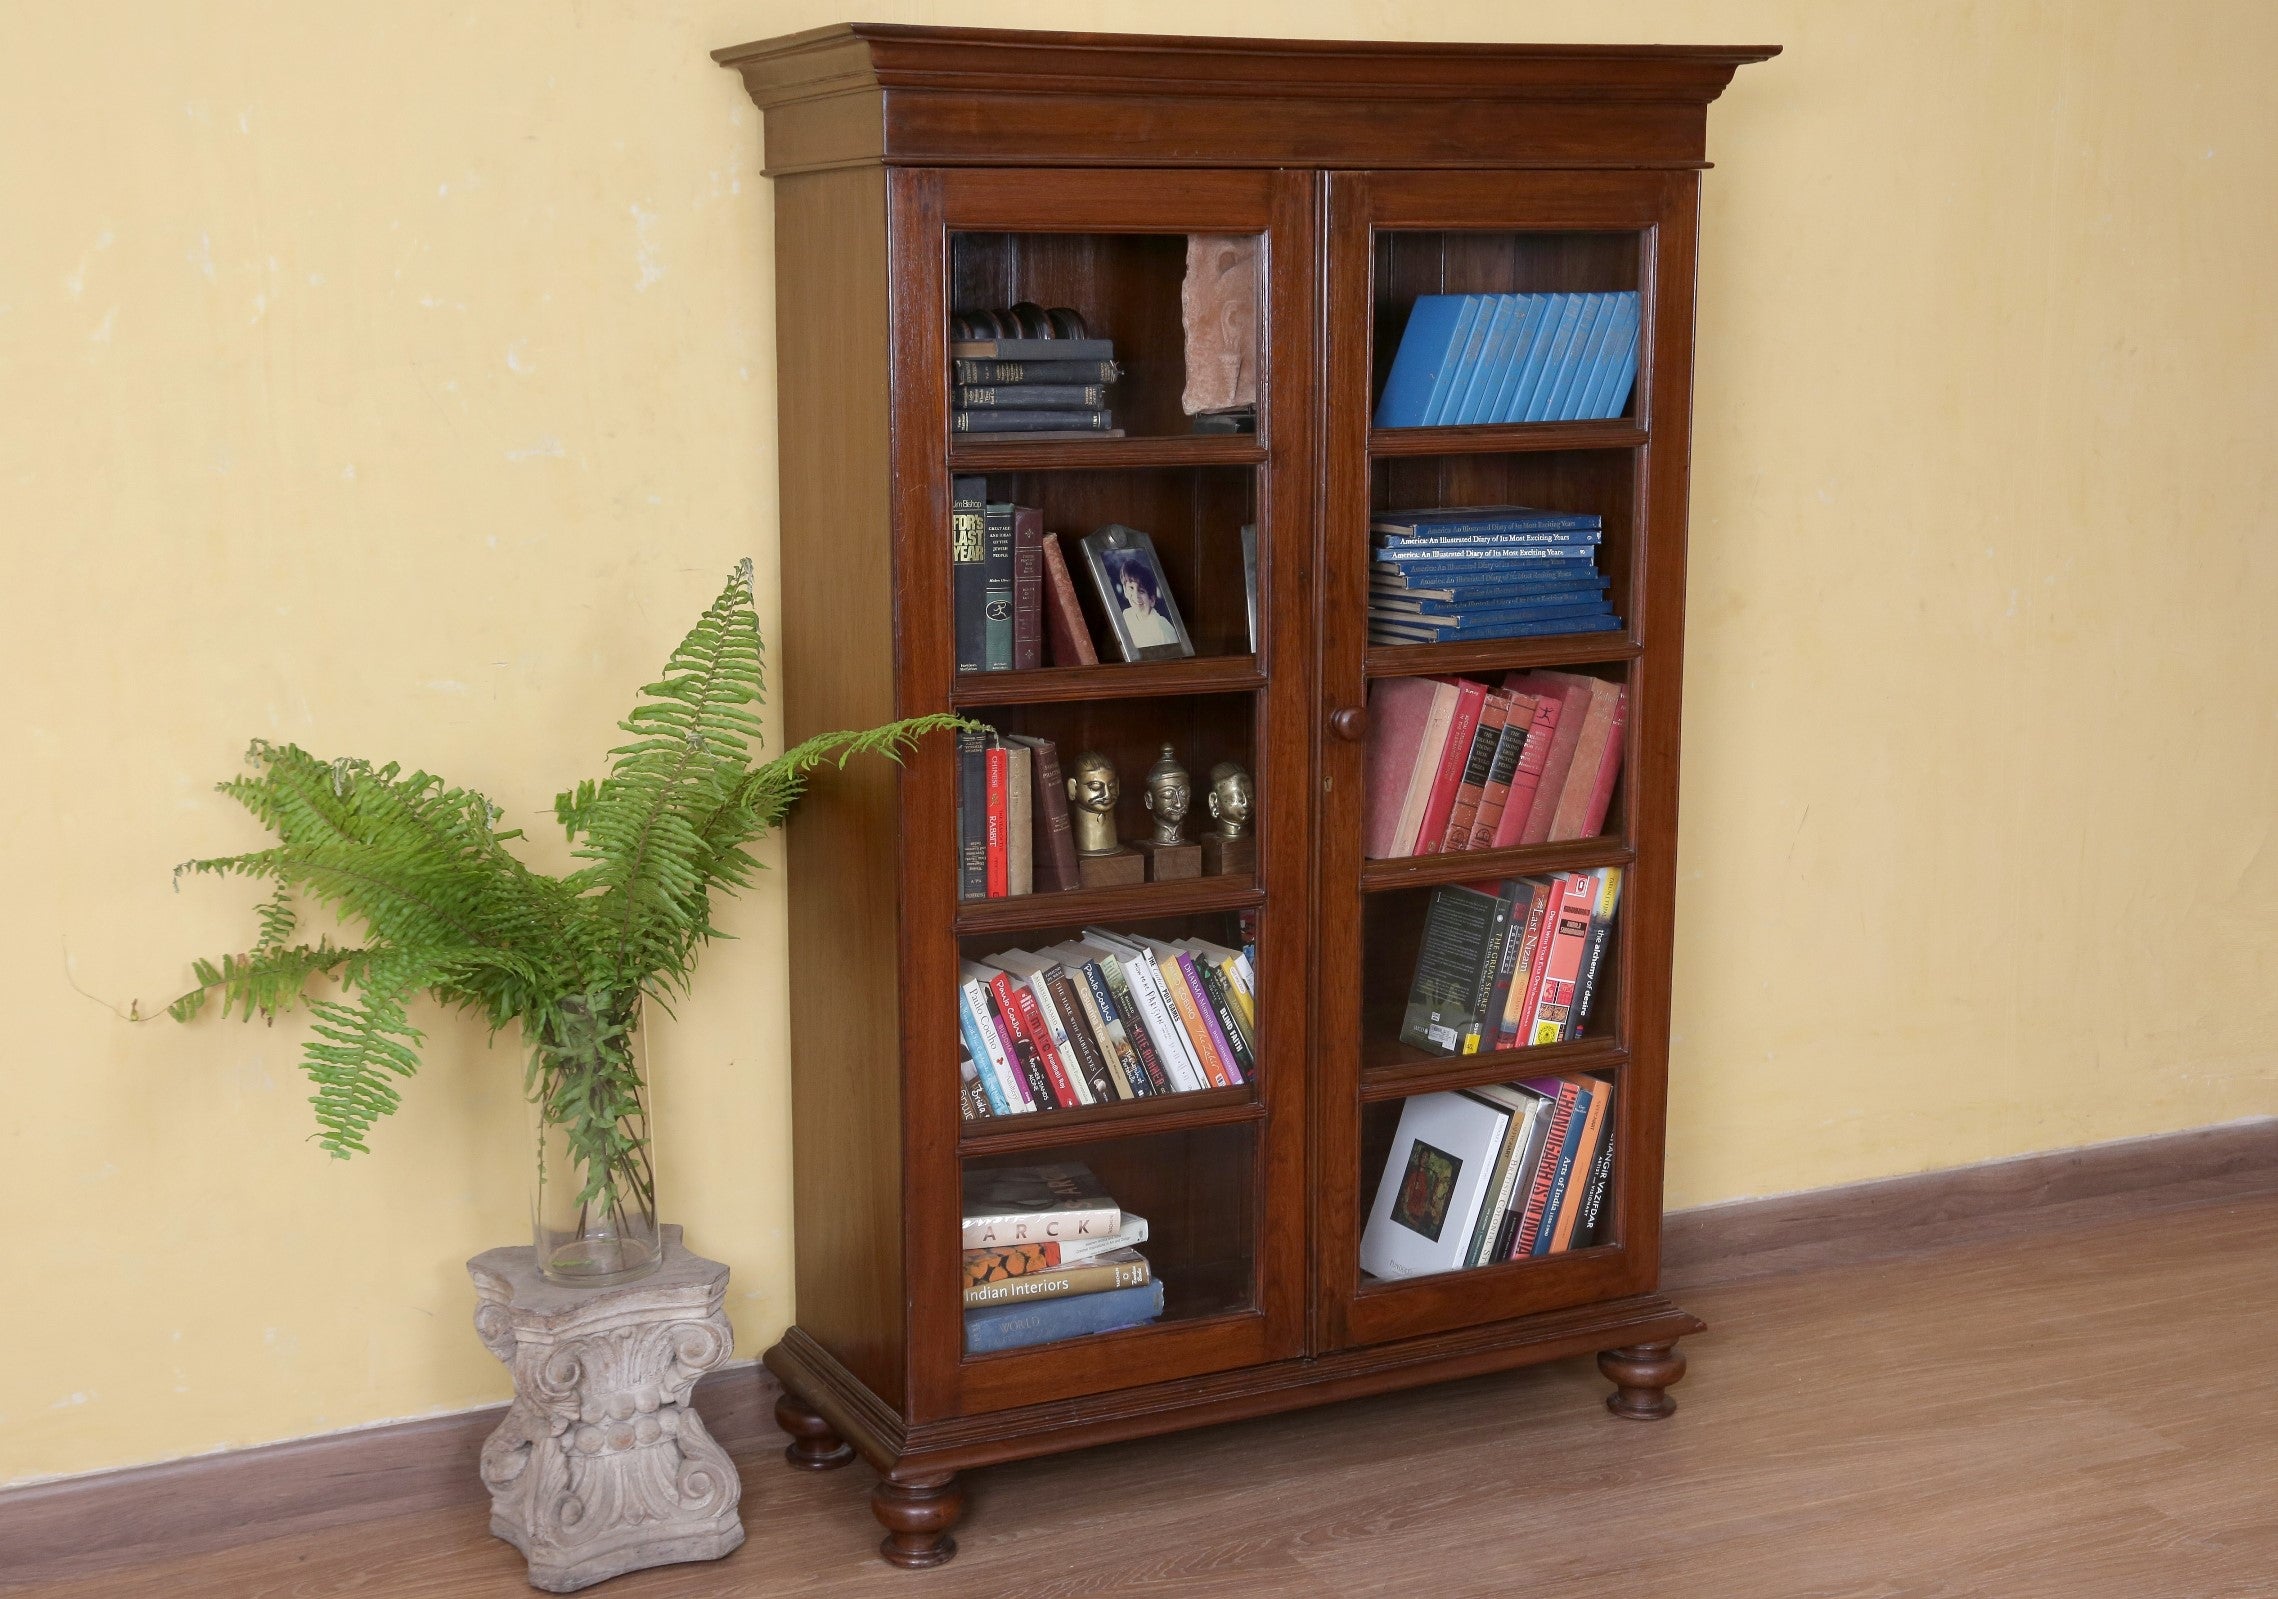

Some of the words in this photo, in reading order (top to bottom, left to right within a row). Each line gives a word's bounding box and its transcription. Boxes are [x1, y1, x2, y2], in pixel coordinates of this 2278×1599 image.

[962, 500, 982, 509] Bishop
[953, 514, 983, 530] FDR's
[953, 530, 984, 546] LAST
[1473, 536, 1490, 544] Diary
[1526, 533, 1552, 542] Exciting
[1553, 533, 1570, 541] Years
[953, 545, 984, 562] YEAR
[1484, 549, 1493, 557] of
[1519, 549, 1546, 558] Exciting
[989, 815, 997, 848] RABBIT
[1530, 908, 1544, 932] Last
[1493, 933, 1502, 949] THE
[1595, 929, 1605, 943] the
[1486, 953, 1498, 980] GREAT
[1521, 935, 1538, 972] Nizam
[1587, 944, 1600, 979] alchemy
[1148, 956, 1156, 967] THE
[1162, 988, 1172, 1005] POLO
[1168, 1003, 1180, 1022] GAMES
[1183, 963, 1202, 999] DHARMA
[1200, 998, 1214, 1028] Moments
[1479, 982, 1492, 1013] SECRET
[1586, 980, 1593, 991] of
[1080, 988, 1099, 1026] Casuarina
[1096, 1023, 1106, 1043] Tree
[1178, 987, 1195, 1020] COELHO
[1580, 990, 1591, 1016] desire
[969, 988, 984, 1015] Paulo
[980, 1015, 997, 1050] Coelho
[1055, 982, 1064, 997] THE
[1062, 997, 1073, 1016] HARE
[1077, 1033, 1090, 1056] AMBER
[1086, 1055, 1096, 1072] EYES
[1220, 1007, 1234, 1031] BLIND
[1230, 1030, 1243, 1052] FAITH
[1133, 1027, 1149, 1051] KITE
[1143, 1049, 1165, 1087] RUNNER
[1535, 1084, 1579, 1182] CHANDIGARH
[1500, 1159, 1517, 1196] BRITISH
[1561, 1157, 1571, 1176] Arts
[1594, 1156, 1602, 1175] ARTIST
[1532, 1182, 1552, 1198] IS
[1558, 1177, 1565, 1189] of
[1527, 1197, 1547, 1214] IN
[1551, 1188, 1563, 1211] India
[1584, 1185, 1596, 1217] VISIONARY
[1586, 1181, 1606, 1229] VAZIFDAR
[1486, 1199, 1506, 1246] COLONIAL
[1516, 1216, 1540, 1255] INDIA
[966, 1285, 1008, 1302] Indian
[1011, 1279, 1070, 1297] Interiors
[1001, 1316, 1040, 1334] WORLD
